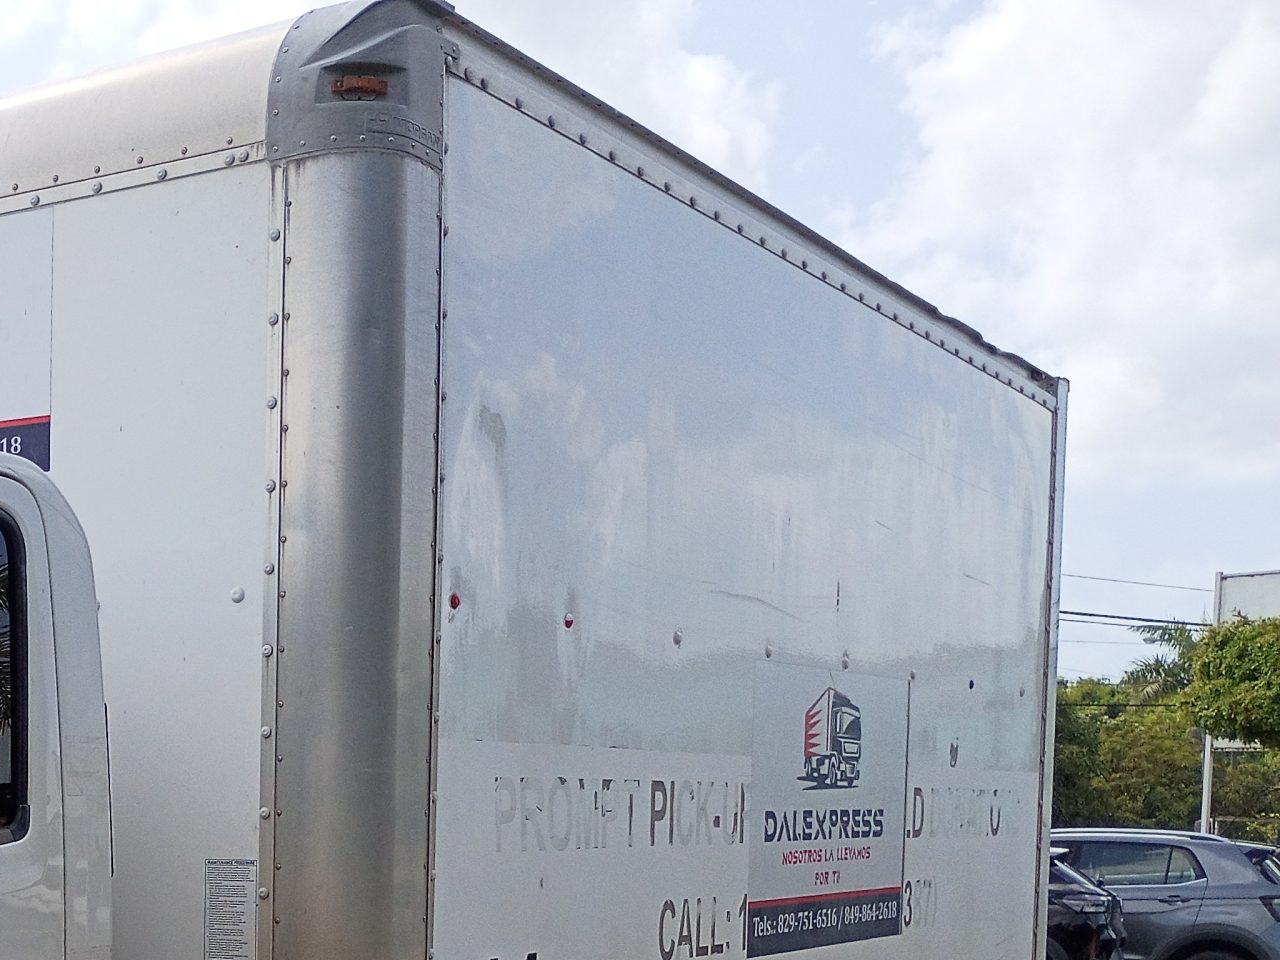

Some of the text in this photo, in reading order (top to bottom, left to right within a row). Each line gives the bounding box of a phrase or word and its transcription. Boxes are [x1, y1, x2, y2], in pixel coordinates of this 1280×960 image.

[764, 808, 884, 843] DALEXPRESS
[782, 846, 871, 865] NOSOTROS LA LLEVAMOS
[814, 870, 829, 885] POR
[752, 916, 777, 936] Tels.:
[778, 908, 837, 934] 829-751-6516
[844, 900, 898, 925] 849-864-2618
